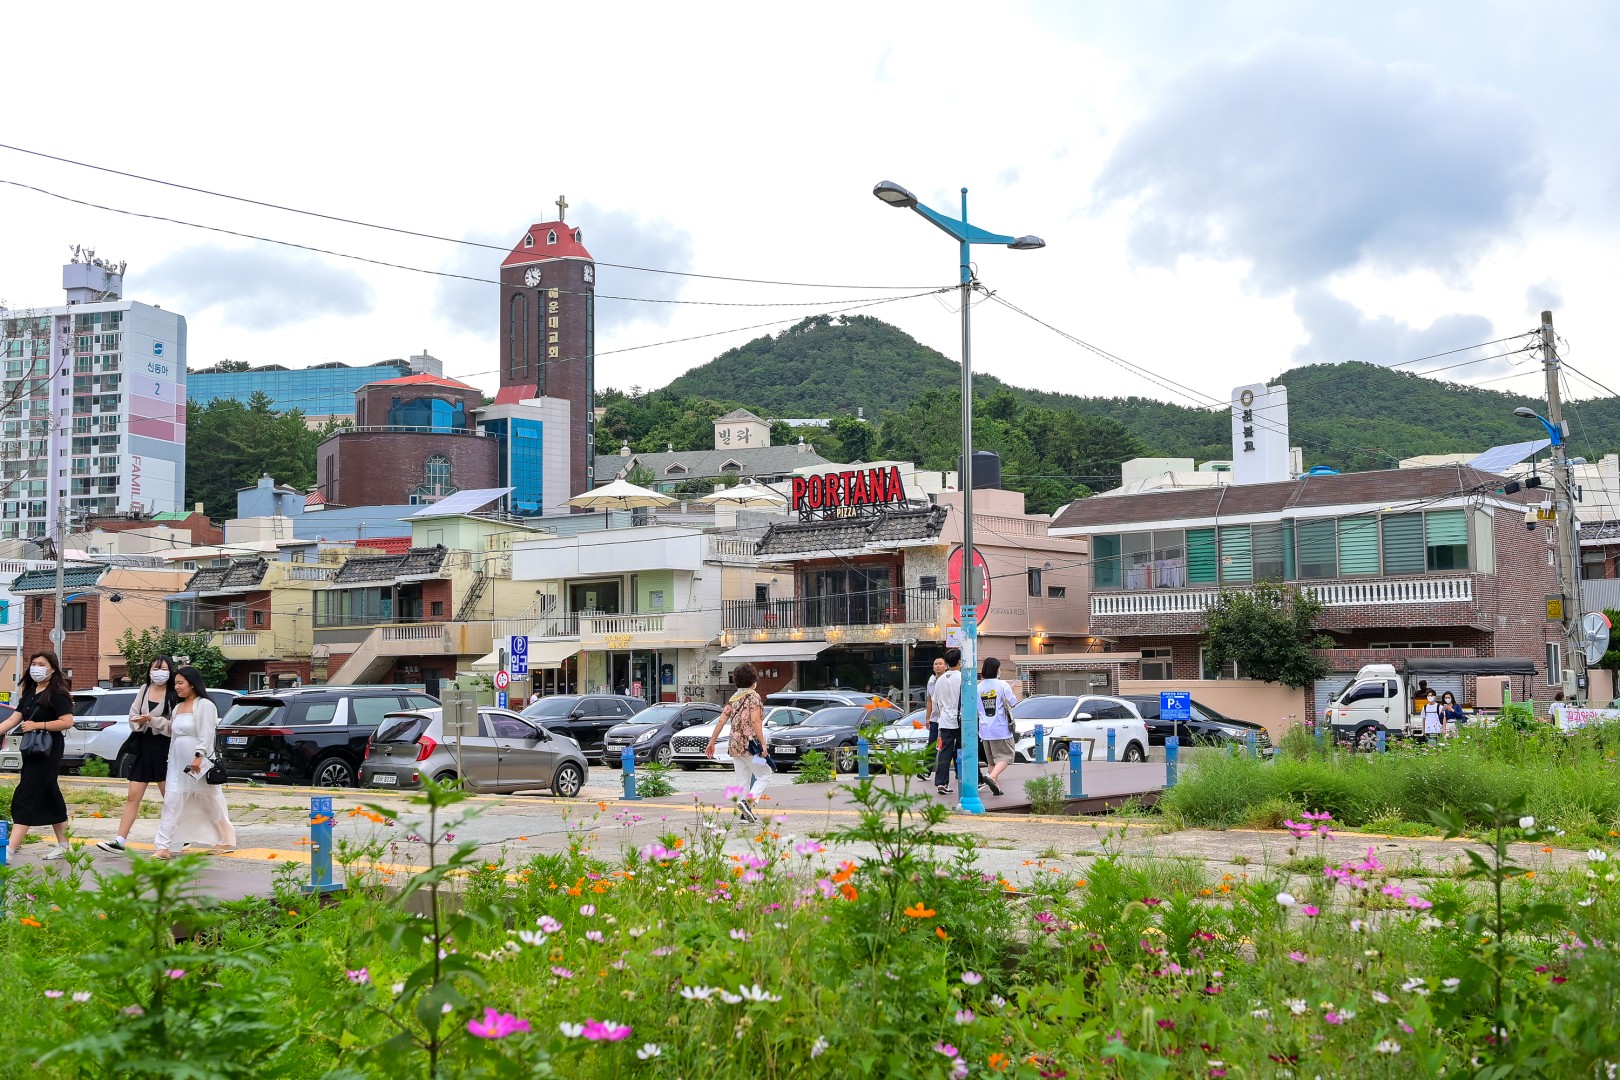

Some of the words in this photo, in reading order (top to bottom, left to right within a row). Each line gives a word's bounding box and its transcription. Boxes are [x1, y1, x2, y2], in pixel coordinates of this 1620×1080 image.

[548, 287, 559, 358] 해운대교회
[147, 362, 169, 376] 신동아
[154, 383, 160, 396] 2
[1242, 408, 1255, 452] 원불교
[792, 466, 903, 511] PORTANA
[836, 506, 857, 518] PIZZA
[511, 654, 527, 672] 입구
[1167, 698, 1175, 709] P
